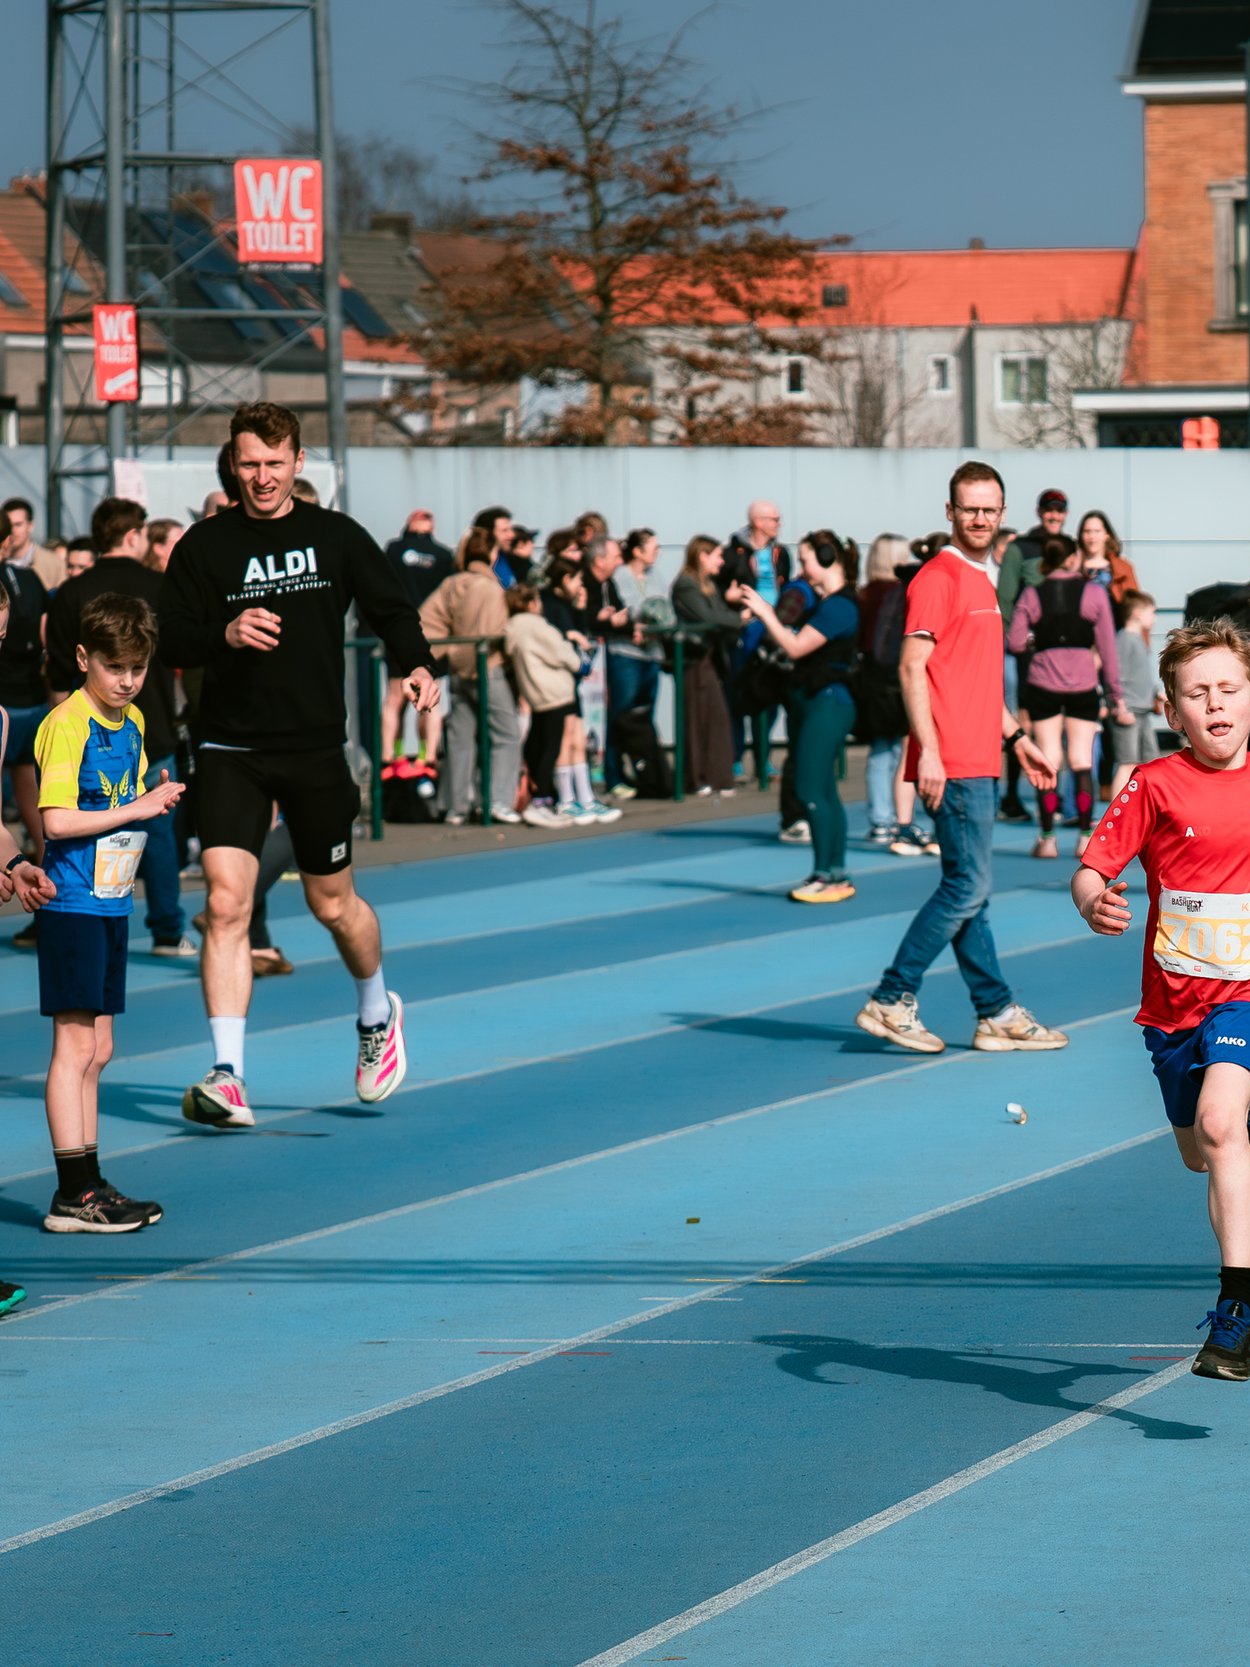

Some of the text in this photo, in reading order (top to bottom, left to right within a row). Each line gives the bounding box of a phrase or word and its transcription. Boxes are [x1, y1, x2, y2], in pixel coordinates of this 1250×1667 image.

[242, 165, 315, 220] WC
[241, 220, 318, 253] TOILET
[98, 310, 136, 342] WC
[243, 547, 317, 583] ALDI
[279, 576, 300, 587] SINCE
[1215, 1035, 1247, 1047] JAKO
